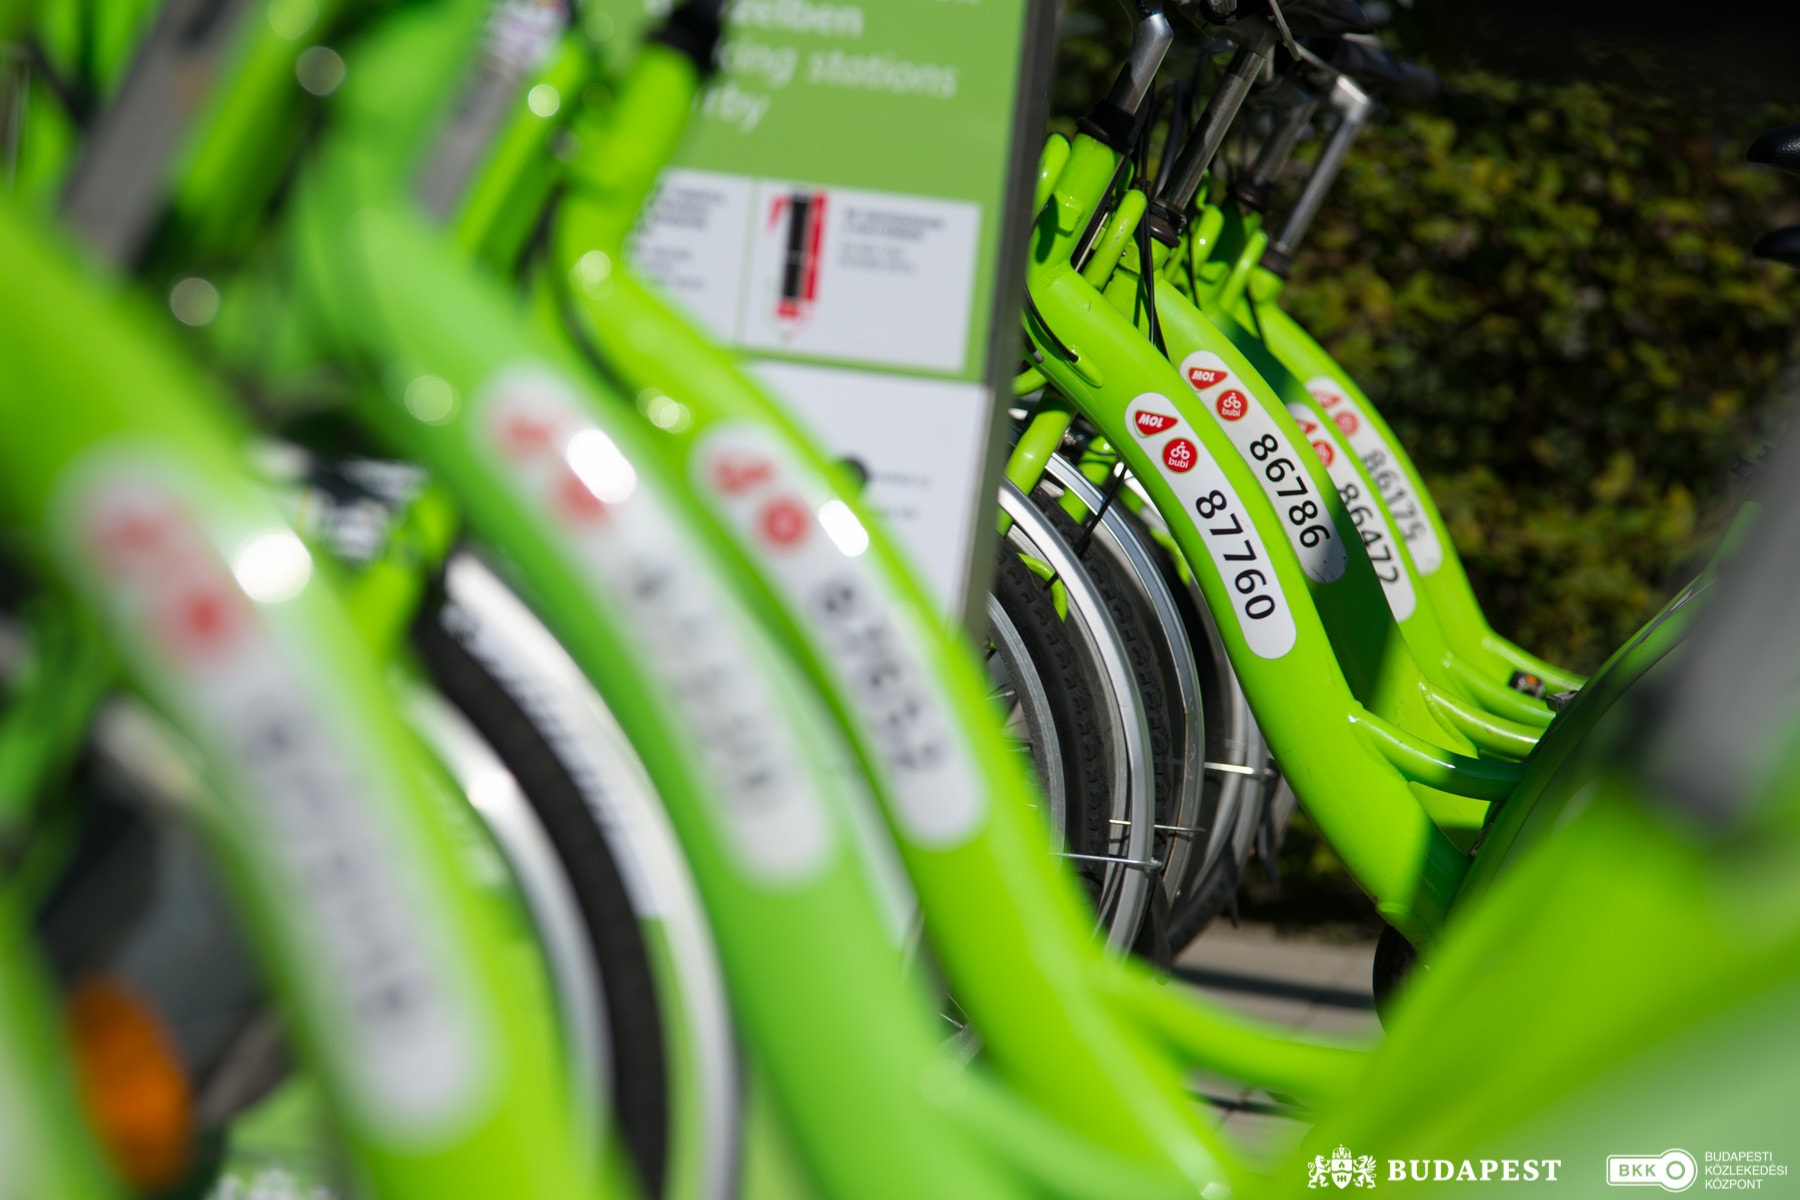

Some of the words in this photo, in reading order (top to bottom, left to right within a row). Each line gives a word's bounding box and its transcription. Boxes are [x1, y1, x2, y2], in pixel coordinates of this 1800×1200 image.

[807, 48, 958, 100] stations
[1191, 369, 1215, 382] MOL
[1138, 413, 1164, 428] MOL
[1221, 406, 1241, 417] bubi
[1168, 456, 1189, 469] bubi
[1250, 434, 1330, 548] 86786
[1361, 448, 1426, 541] 86175
[1195, 489, 1275, 620] 87760
[1338, 483, 1399, 583] 86472
